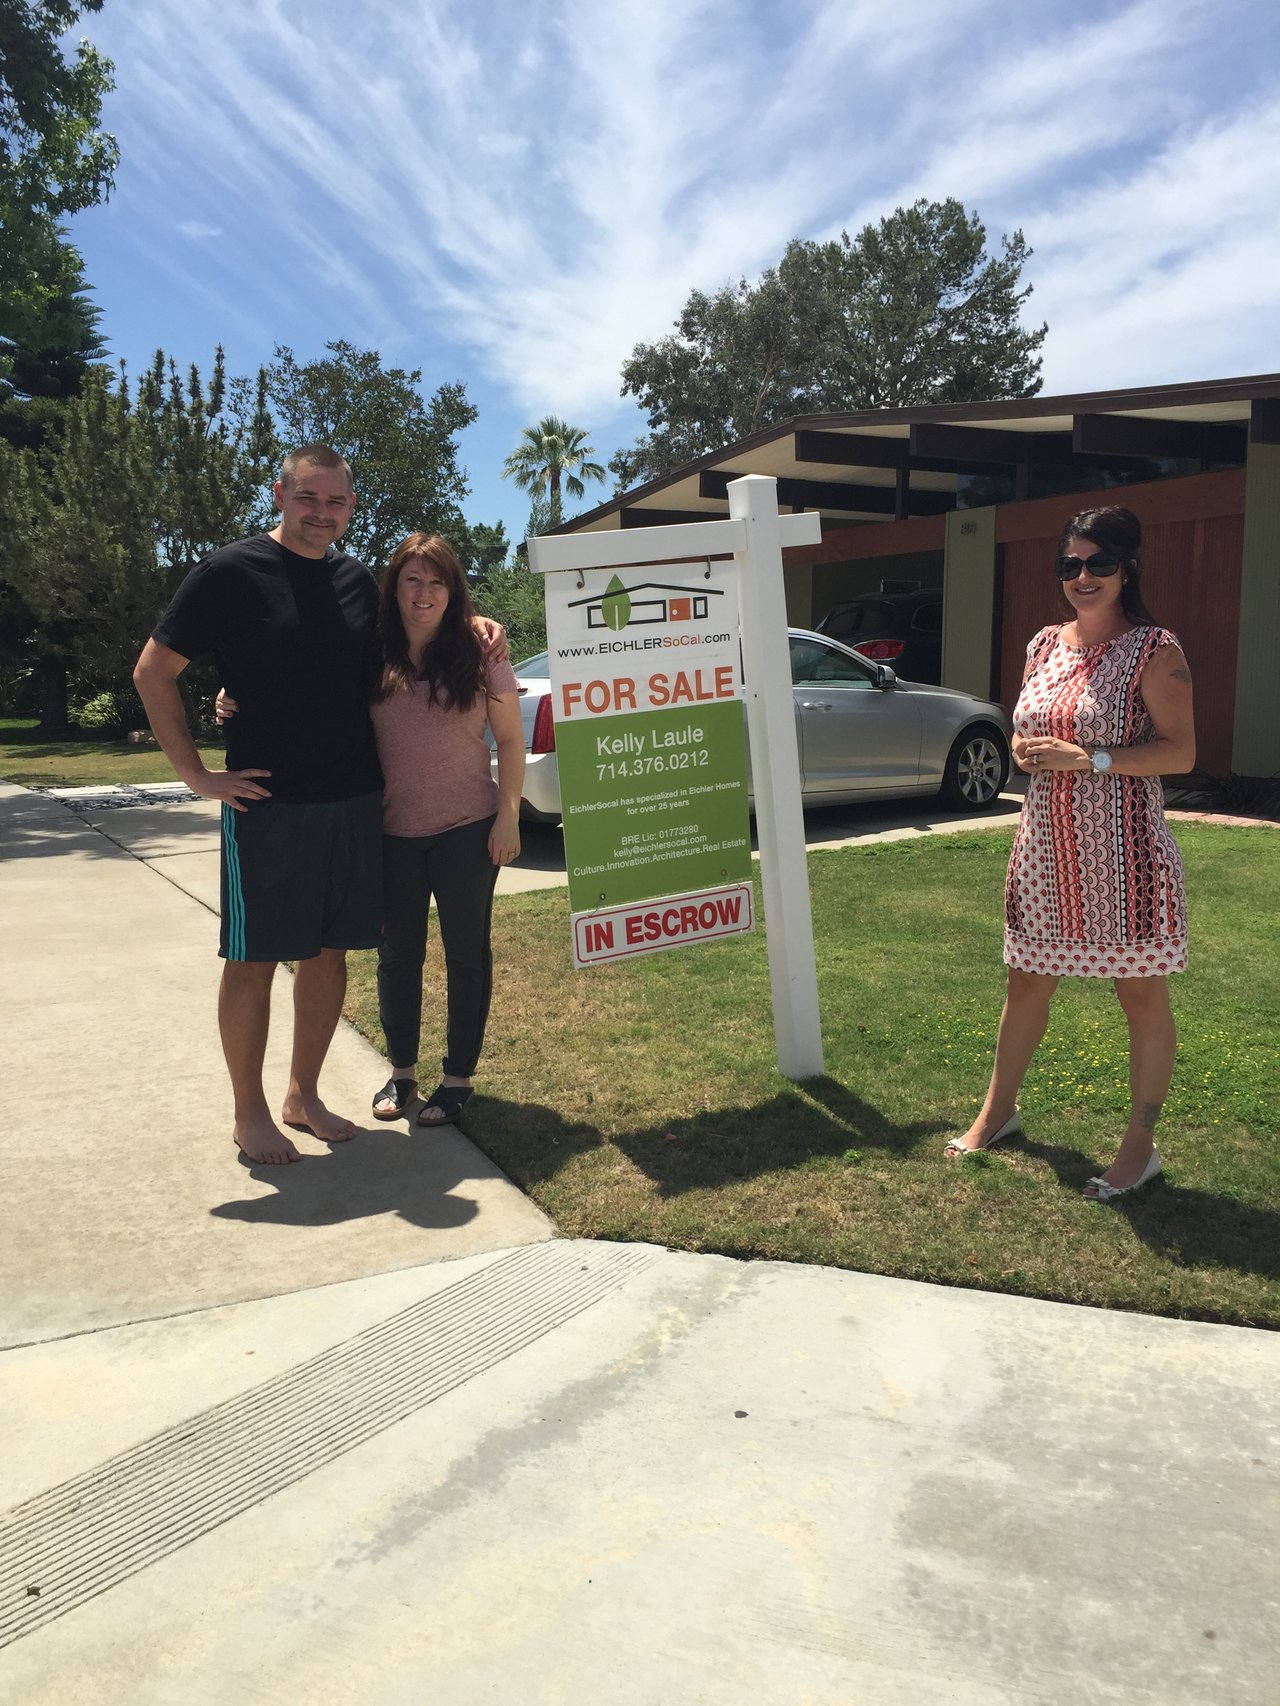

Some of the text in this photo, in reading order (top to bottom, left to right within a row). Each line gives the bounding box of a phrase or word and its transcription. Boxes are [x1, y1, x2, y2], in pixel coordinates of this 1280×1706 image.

[557, 632, 731, 658] www.EICHLERSoCal.com
[562, 665, 735, 717] FOR SALE
[596, 725, 704, 756] Kelly Laule
[596, 749, 709, 781] 714.376.0212
[620, 797, 635, 807] has
[636, 789, 679, 805] specialized
[679, 786, 688, 797] in
[689, 782, 714, 796] Eichler
[715, 780, 741, 791] Homes
[627, 799, 690, 816] for over 25 years
[613, 834, 708, 859] kelly@eichlersocal.com
[621, 824, 699, 846] BRE Lic: 01773280
[722, 838, 746, 850] Estate
[585, 896, 742, 953] IN ESCROW
